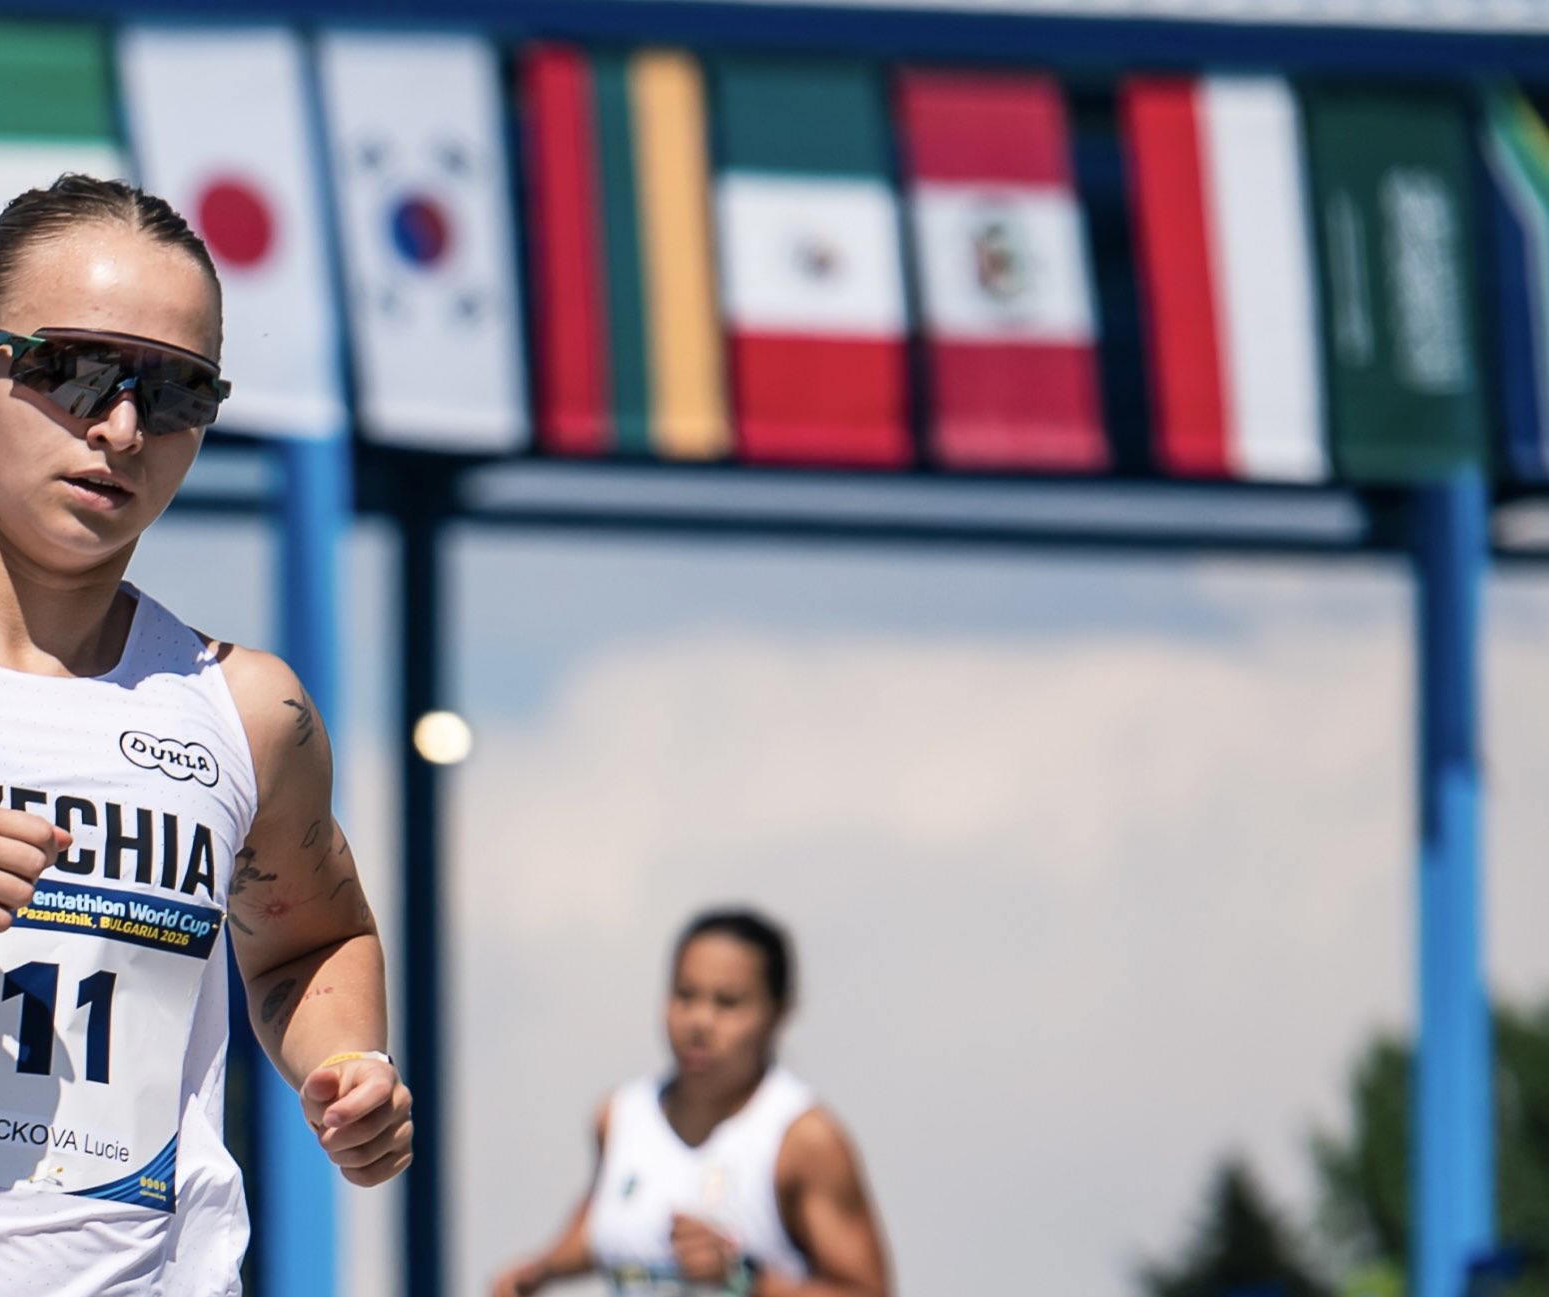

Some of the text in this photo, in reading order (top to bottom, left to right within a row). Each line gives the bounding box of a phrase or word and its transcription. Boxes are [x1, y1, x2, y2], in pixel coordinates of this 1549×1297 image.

[16, 905, 191, 947] Pazardzhik, BULGARIA 2026
[32, 890, 211, 938] entathlon World Cup
[2, 961, 117, 1085] 11
[84, 1133, 130, 1162] Lucie
